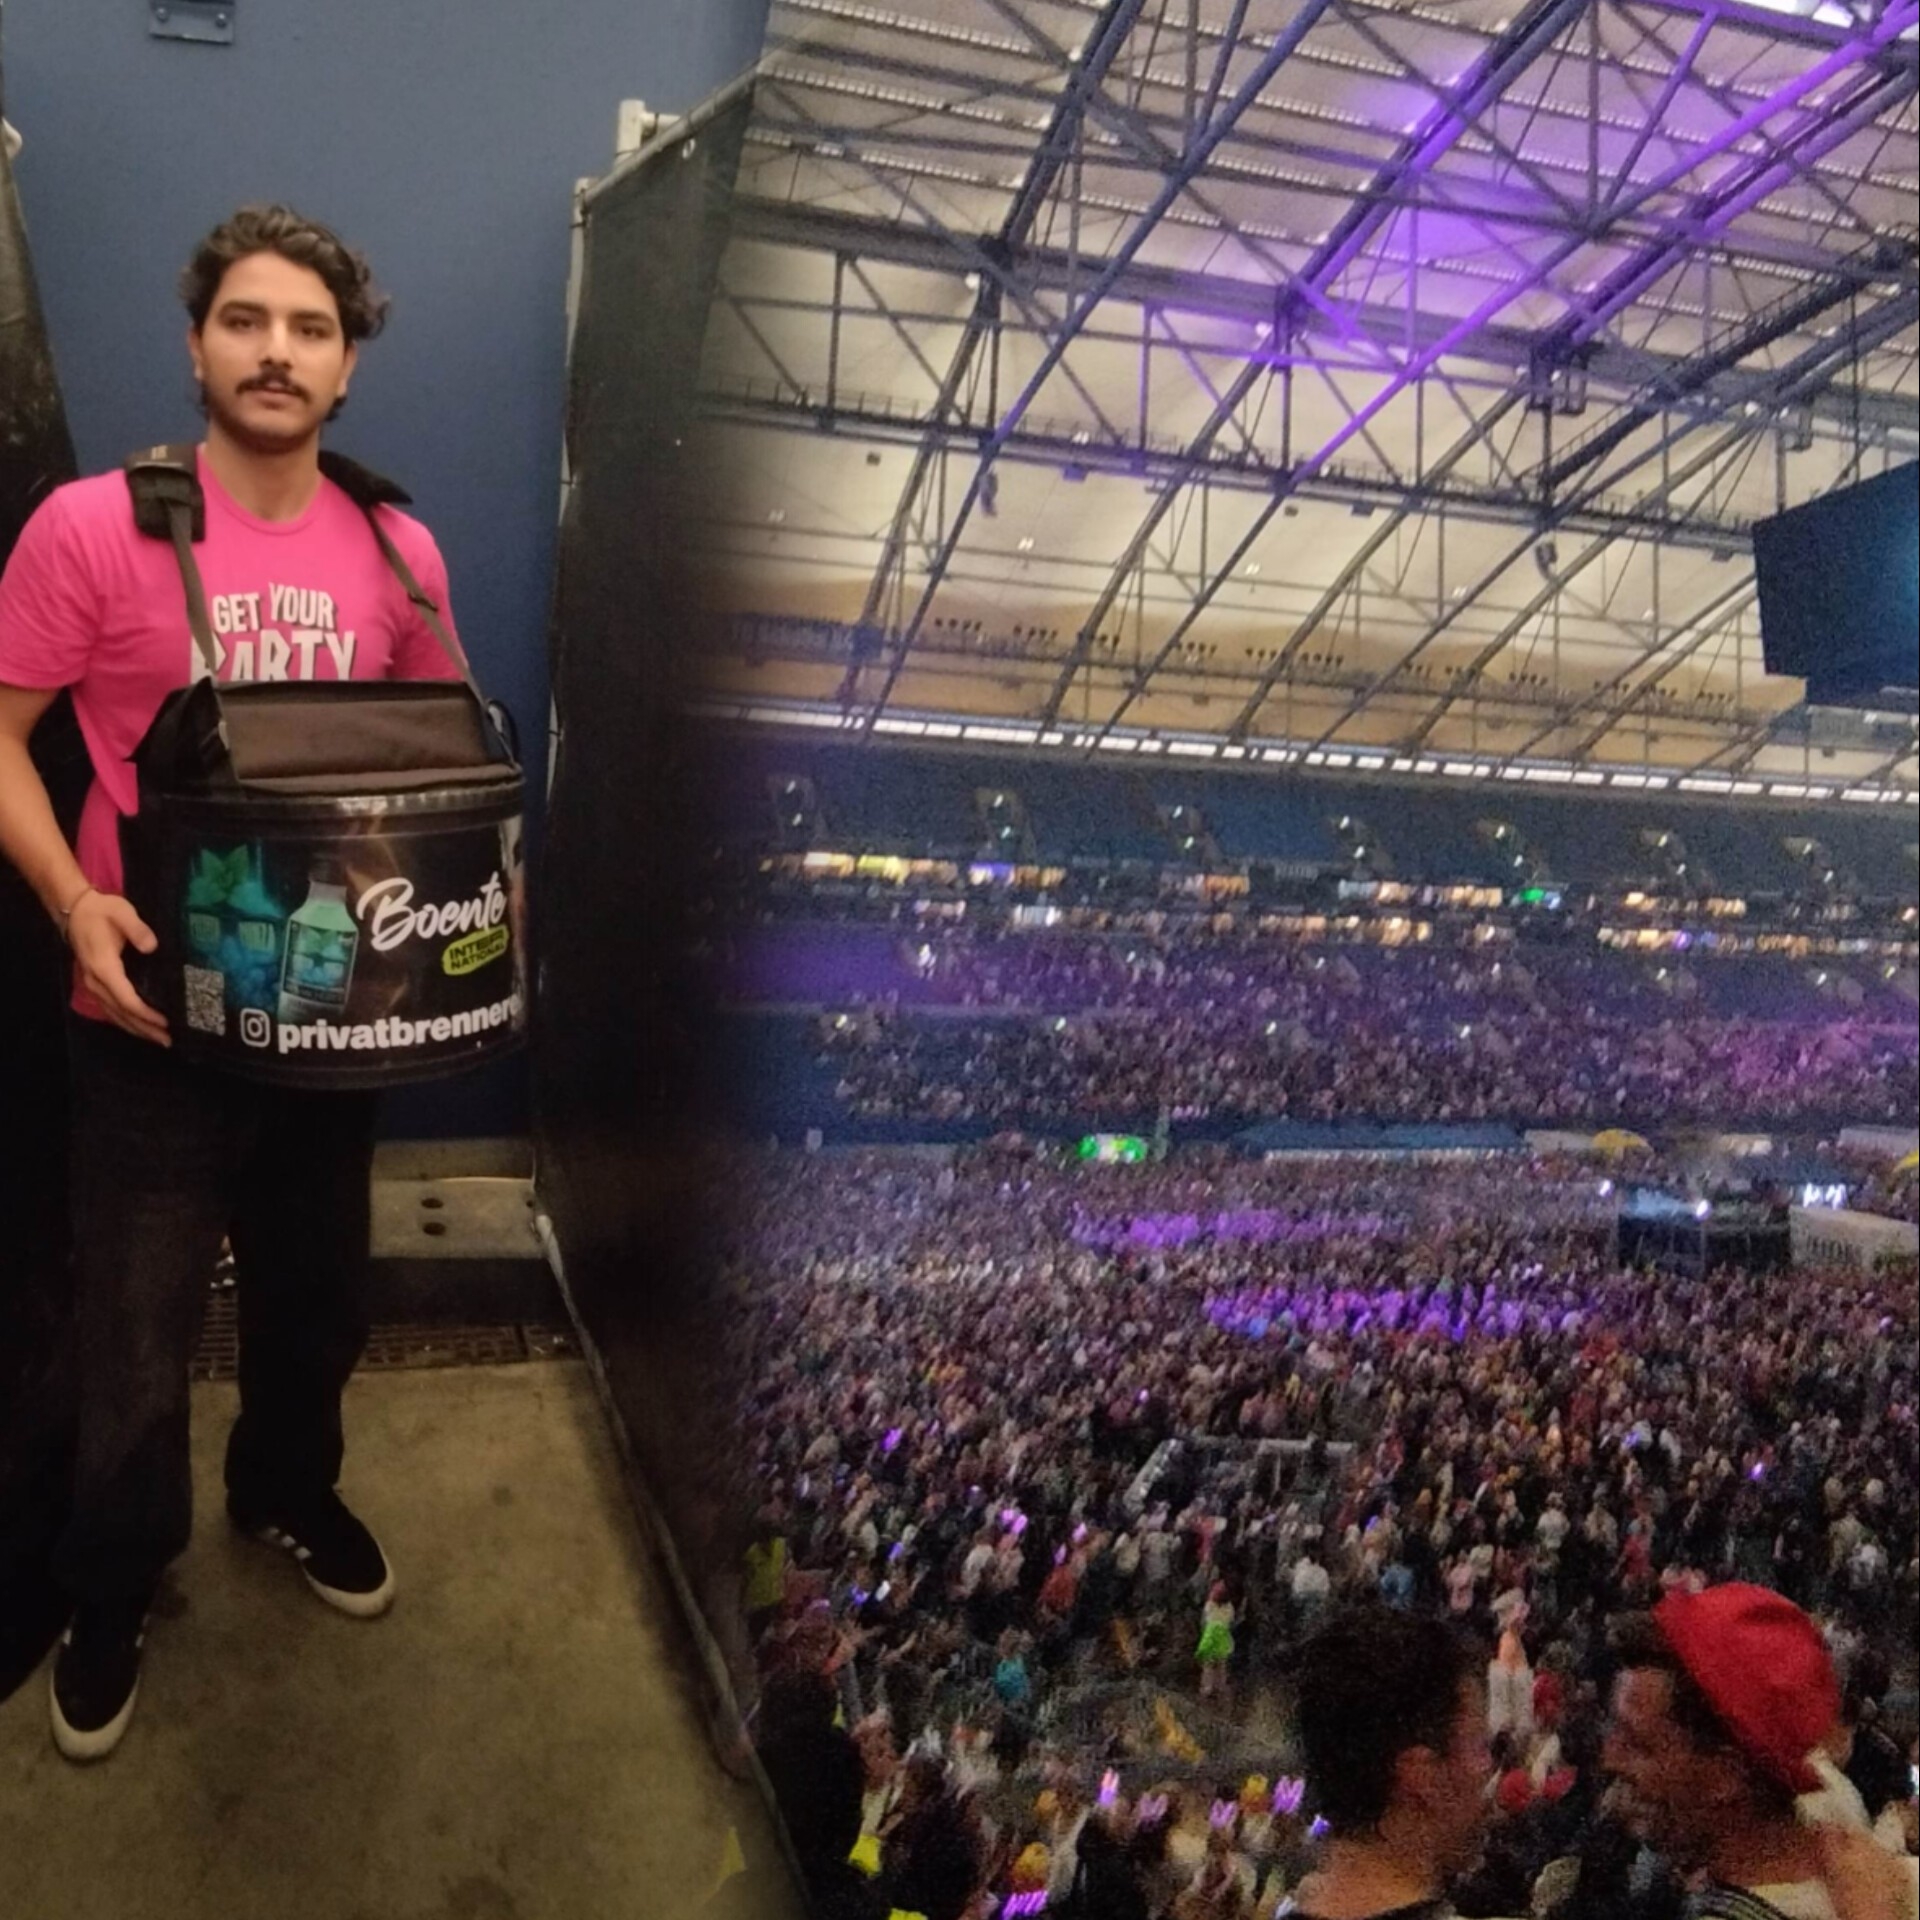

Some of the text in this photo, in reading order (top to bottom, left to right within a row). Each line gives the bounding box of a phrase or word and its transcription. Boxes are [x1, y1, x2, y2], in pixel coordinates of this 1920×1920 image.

[212, 582, 334, 633] GET YOUR
[190, 629, 355, 683] PARTY
[356, 871, 507, 951] Boente
[449, 929, 504, 960] INTER
